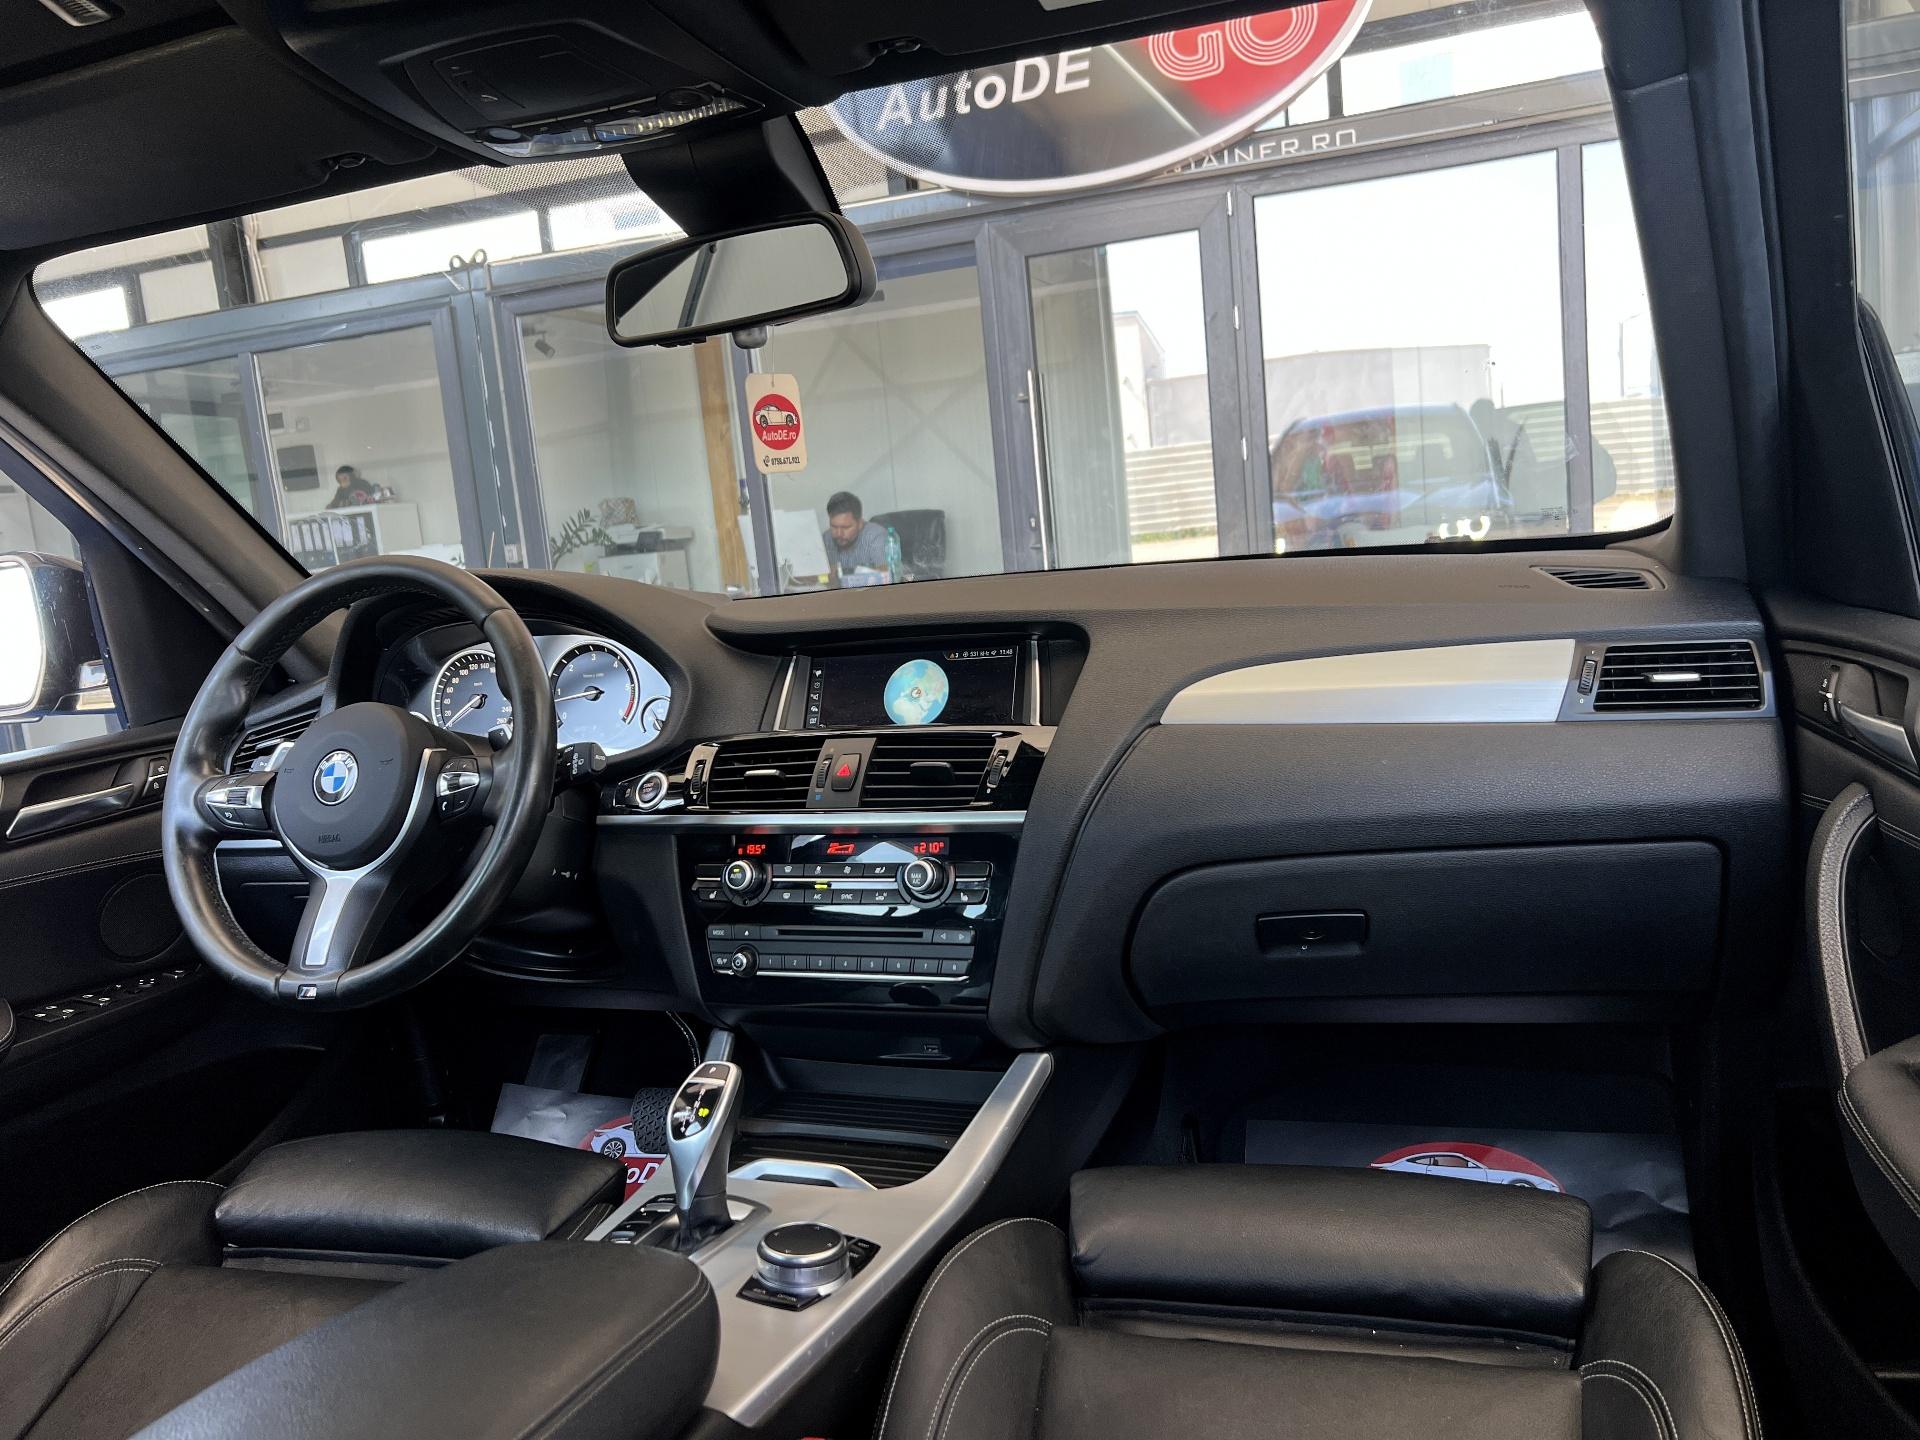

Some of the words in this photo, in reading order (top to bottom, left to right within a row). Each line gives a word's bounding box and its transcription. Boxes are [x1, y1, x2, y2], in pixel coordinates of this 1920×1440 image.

[877, 46, 1092, 131] AutoDE
[762, 430, 797, 441] AutoDE.ro
[709, 1066, 717, 1074] P
